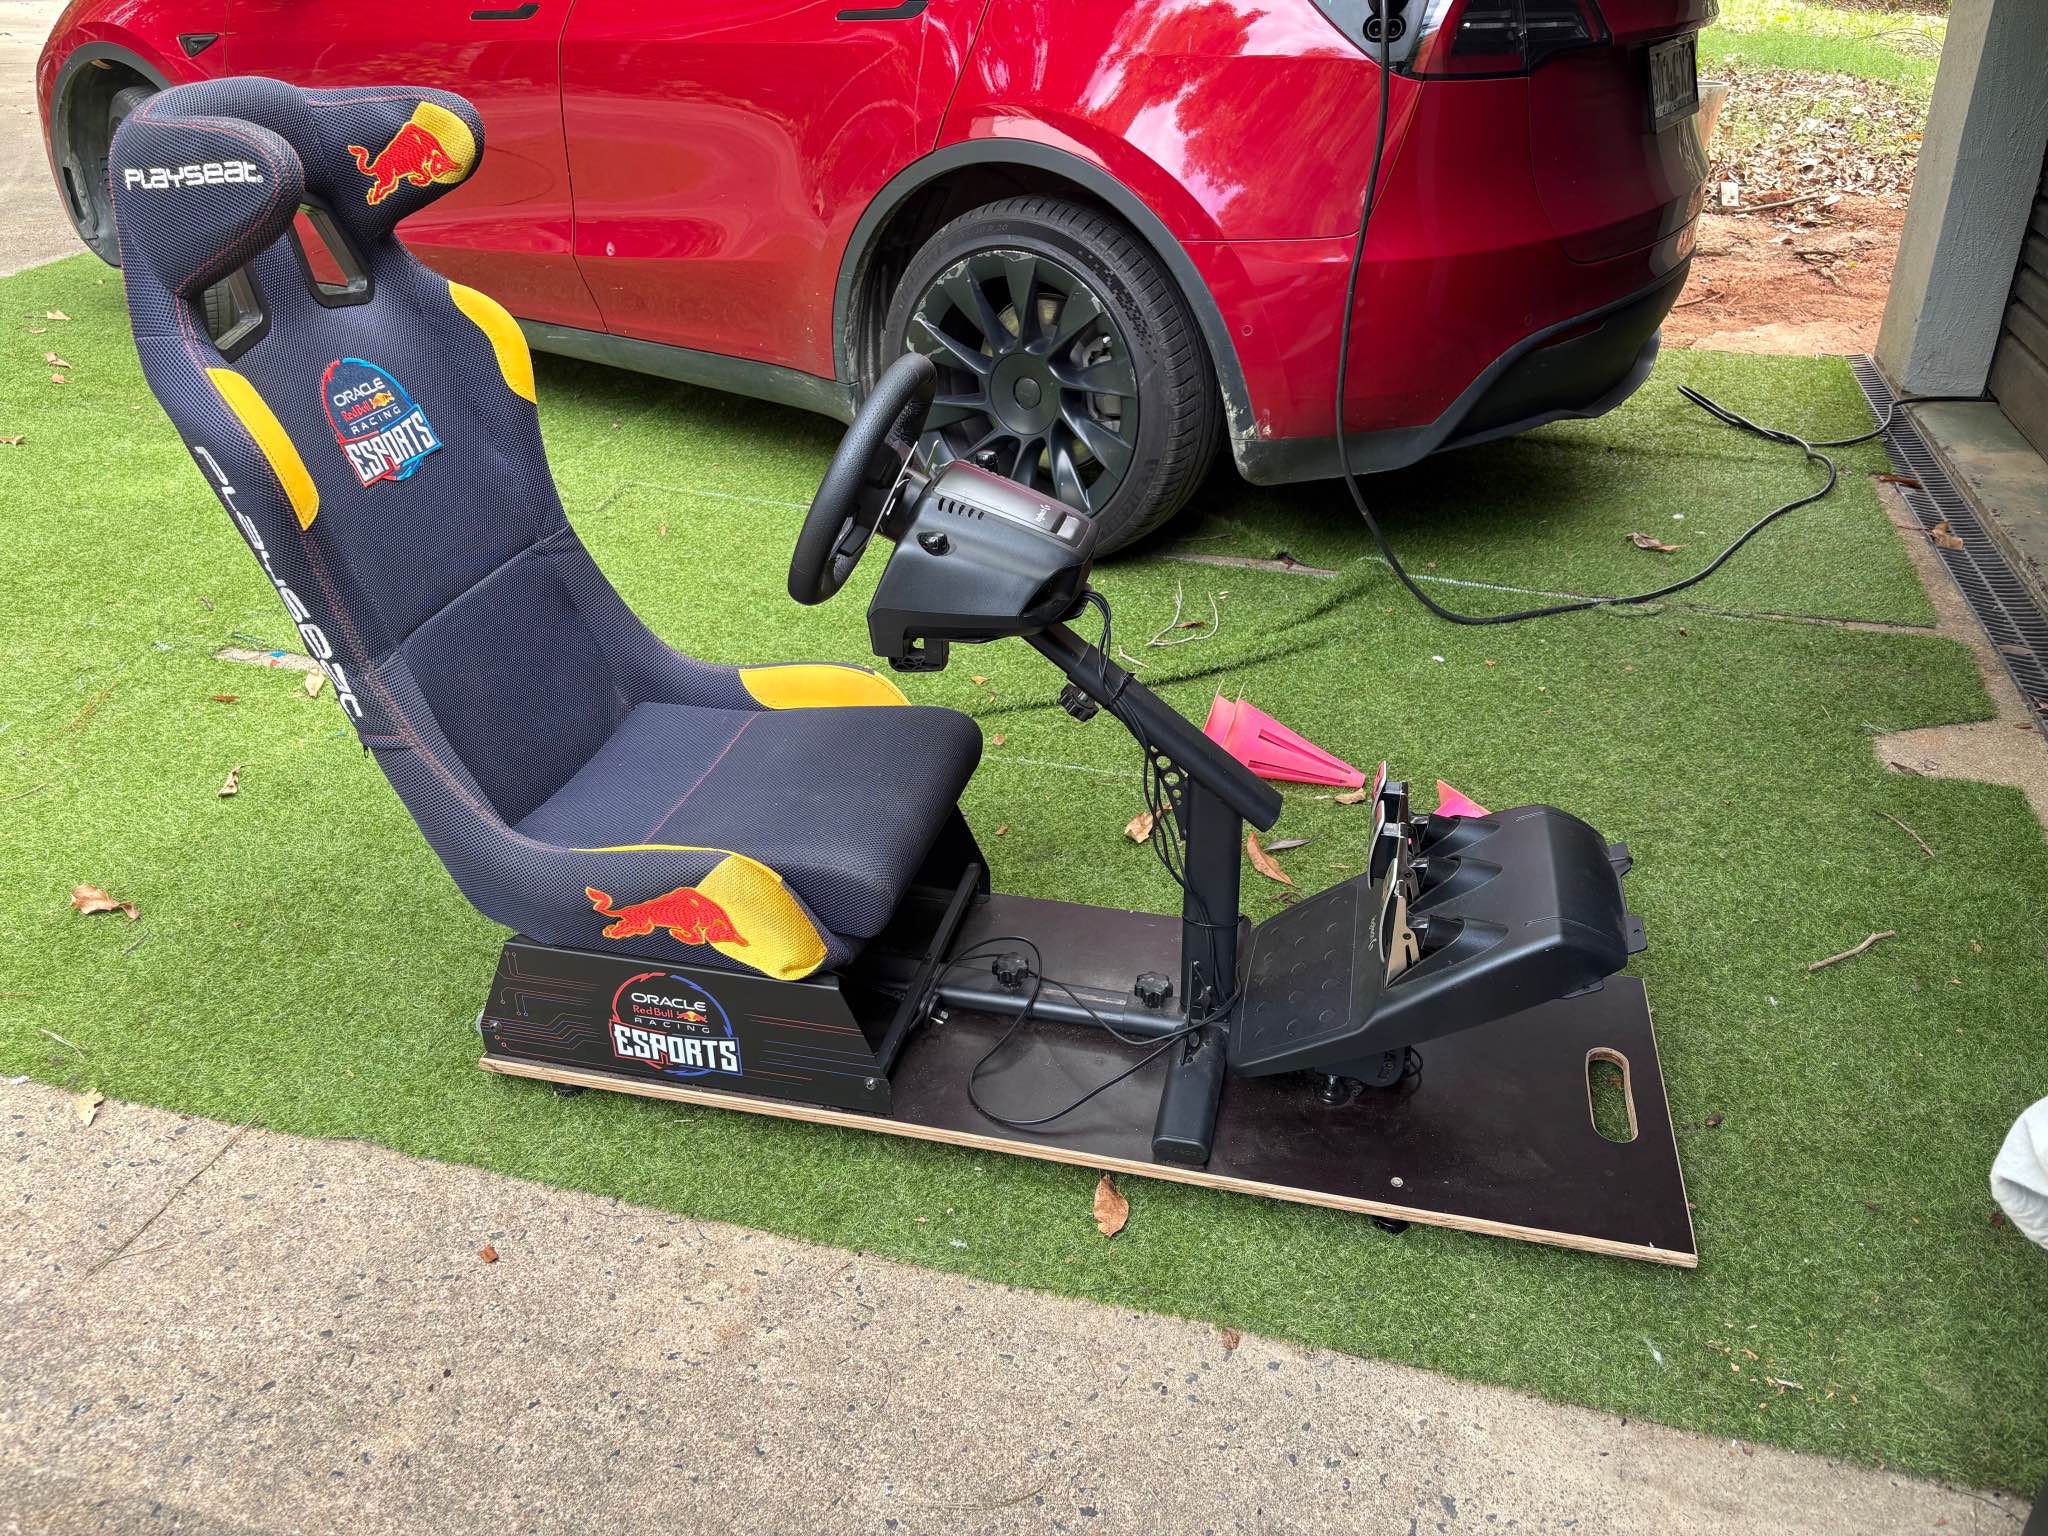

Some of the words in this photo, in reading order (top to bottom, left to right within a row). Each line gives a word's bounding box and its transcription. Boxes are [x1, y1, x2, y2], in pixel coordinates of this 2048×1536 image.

[333, 377, 386, 407] ORACLE
[350, 405, 401, 435] RACING
[344, 411, 438, 481] ESPORTS
[631, 992, 707, 1012] ORACLE
[634, 1017, 711, 1034] RACING
[613, 1023, 739, 1073] ESPORTS
